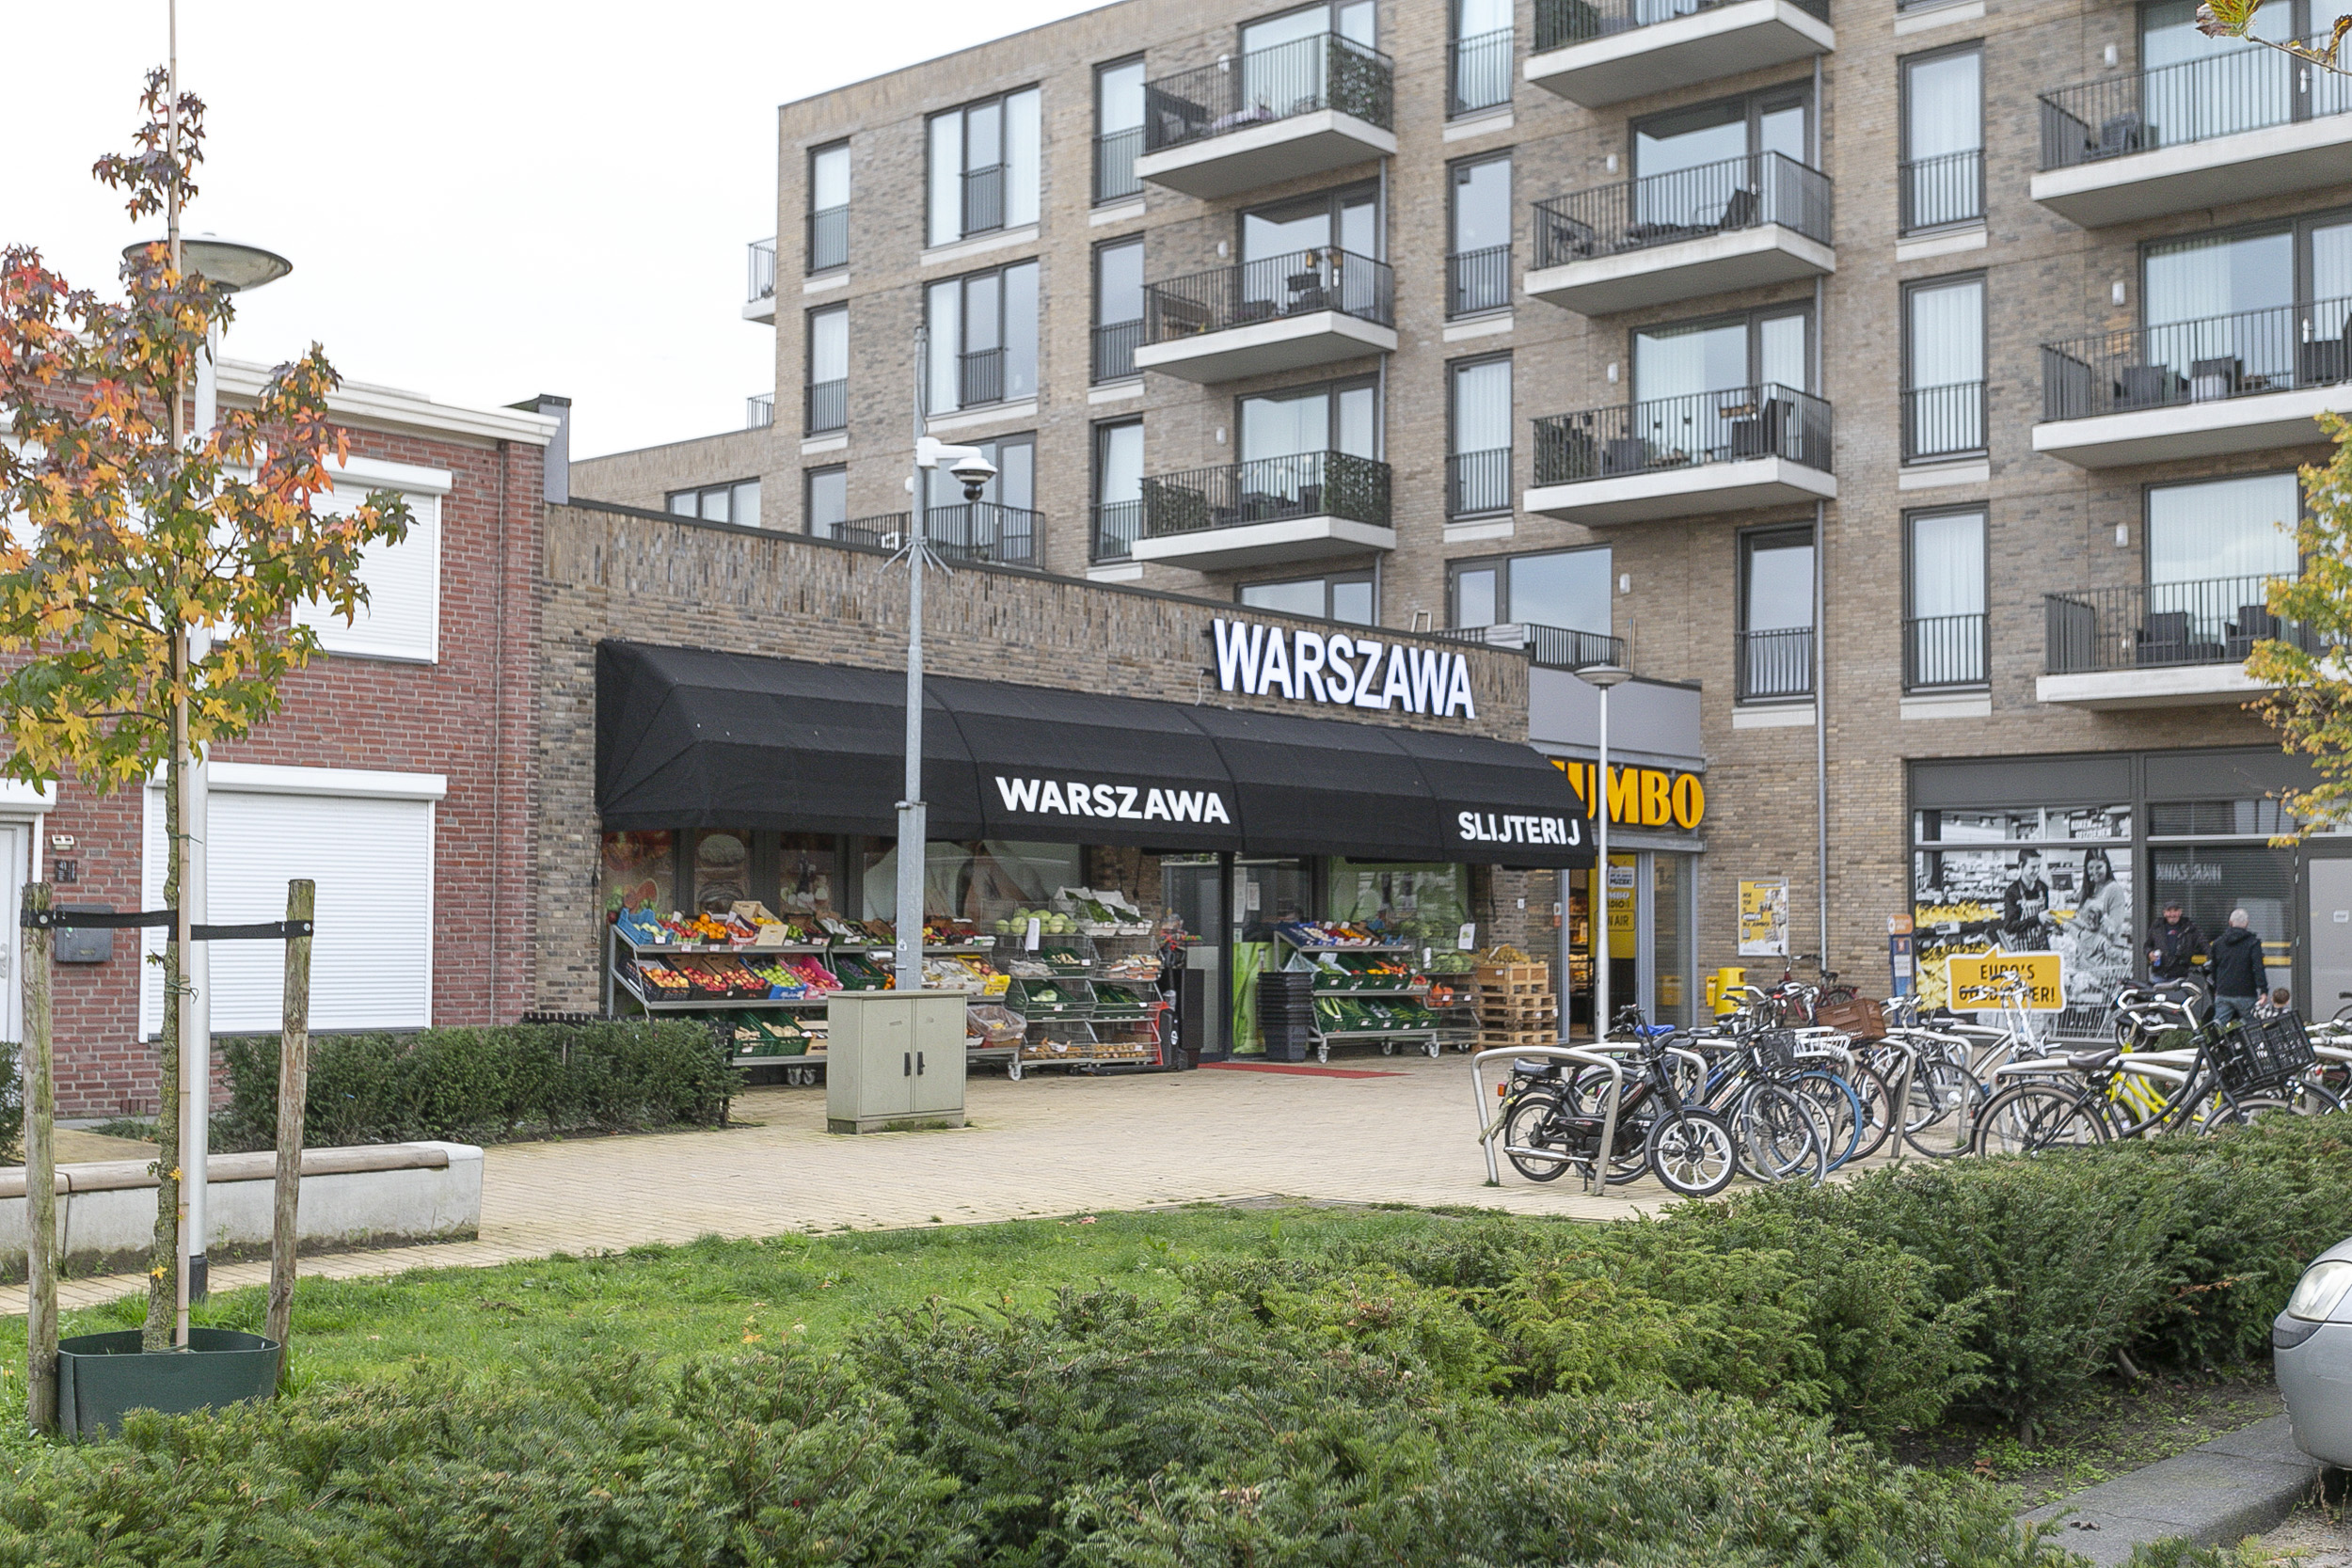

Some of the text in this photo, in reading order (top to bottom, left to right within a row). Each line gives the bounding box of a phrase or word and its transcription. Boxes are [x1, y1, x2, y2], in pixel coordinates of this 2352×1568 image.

[1214, 618, 1475, 719] WARSZAWA
[994, 776, 1231, 824] WARSZAWA
[1550, 759, 1706, 830] UMBO
[1458, 811, 1581, 846] SLIJTERIJ
[1979, 963, 2035, 980] EURO'S
[1959, 984, 2056, 1003] GODER!
